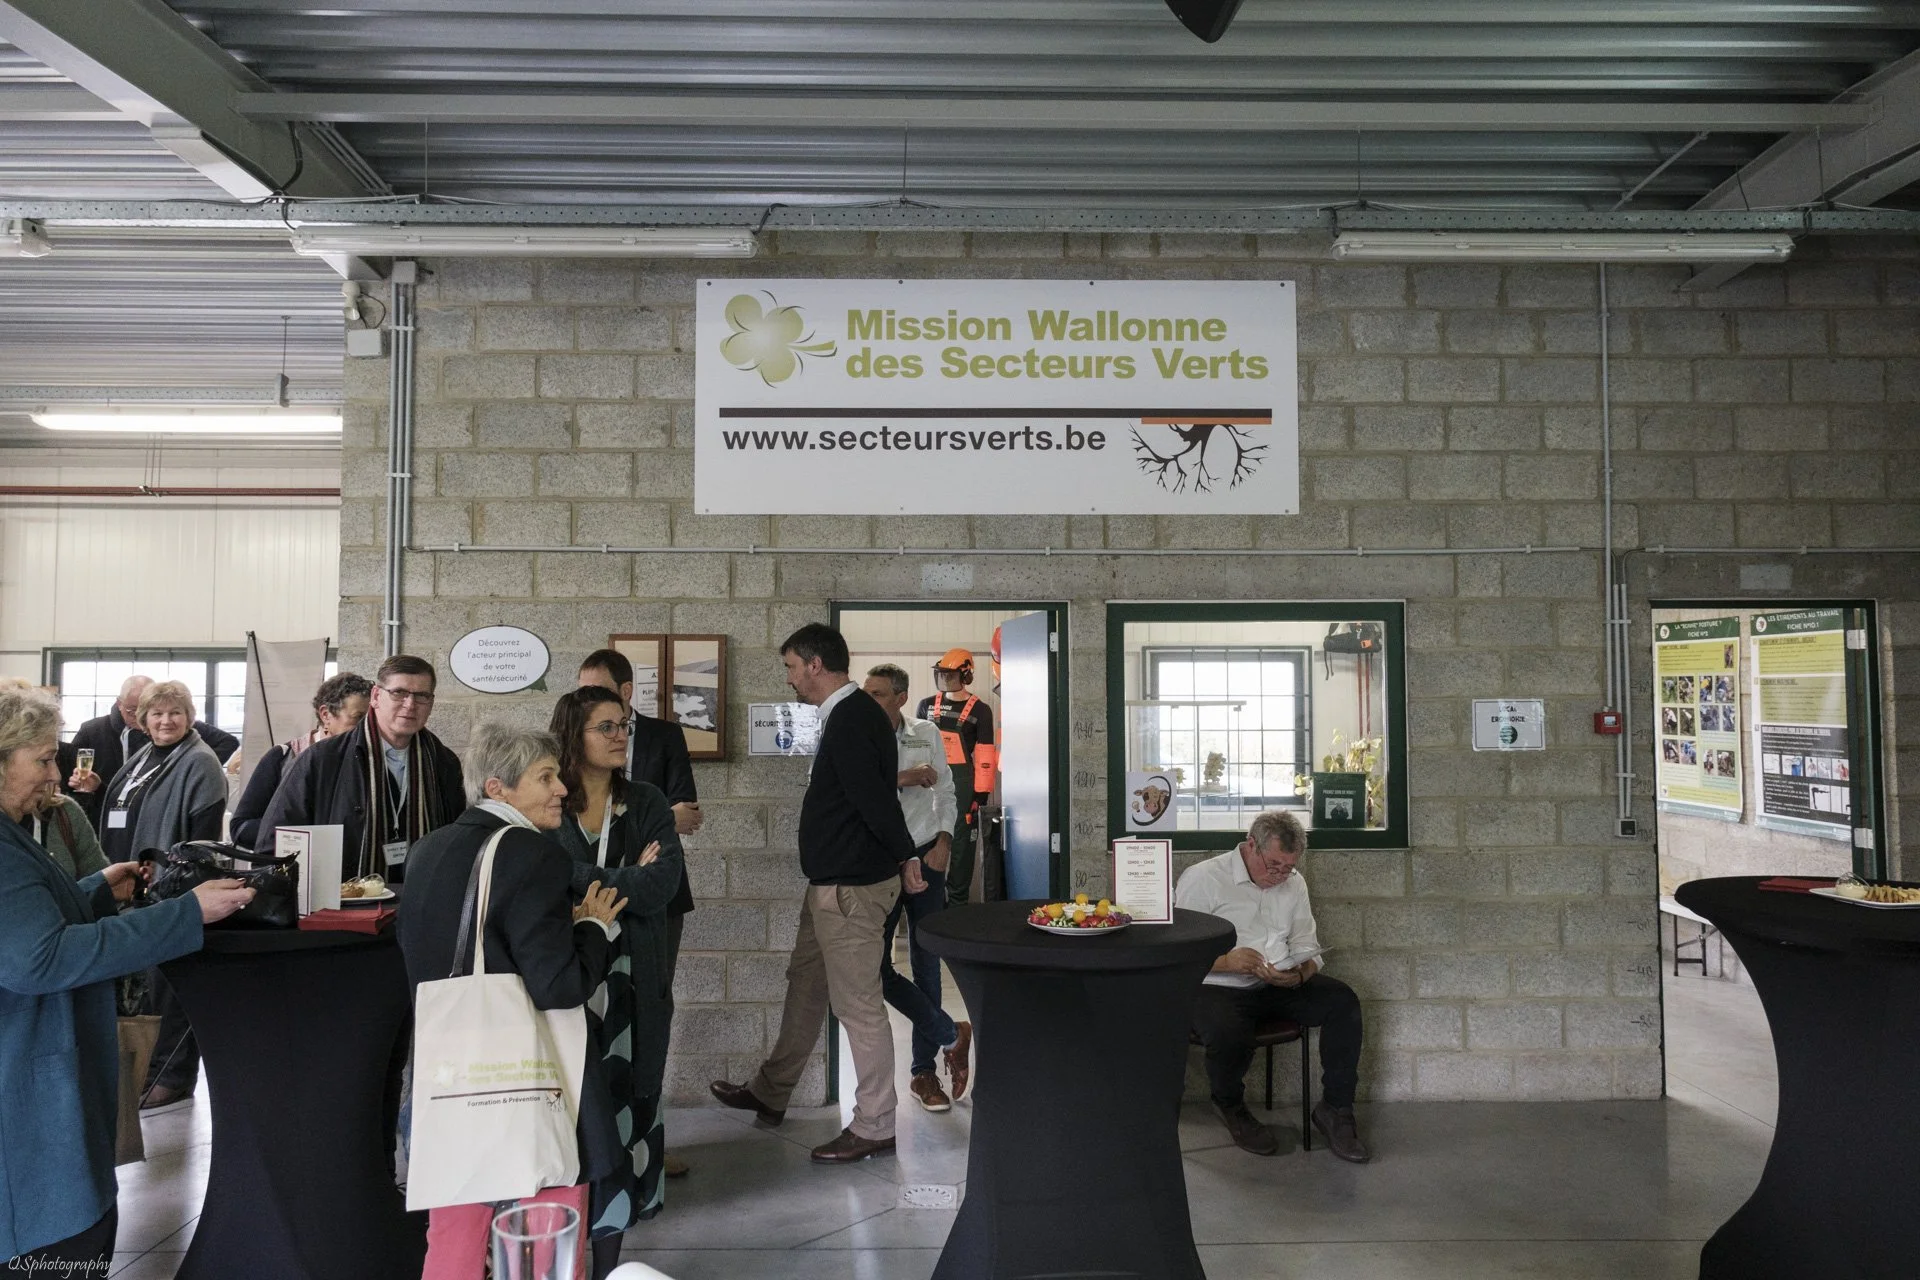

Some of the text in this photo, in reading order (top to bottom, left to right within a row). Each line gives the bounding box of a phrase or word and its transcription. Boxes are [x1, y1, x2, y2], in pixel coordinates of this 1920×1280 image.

[848, 310, 1227, 341] Mission Wallonne
[846, 347, 1268, 379] des Secteurs Verts
[722, 424, 1106, 451] www.secteursverts.be
[498, 651, 532, 660] principal
[483, 663, 492, 671] de
[472, 675, 528, 683] santé/sécurité
[755, 719, 783, 727] SÉCURIT
[1075, 869, 1087, 888] 80
[467, 1099, 501, 1107] Formation
